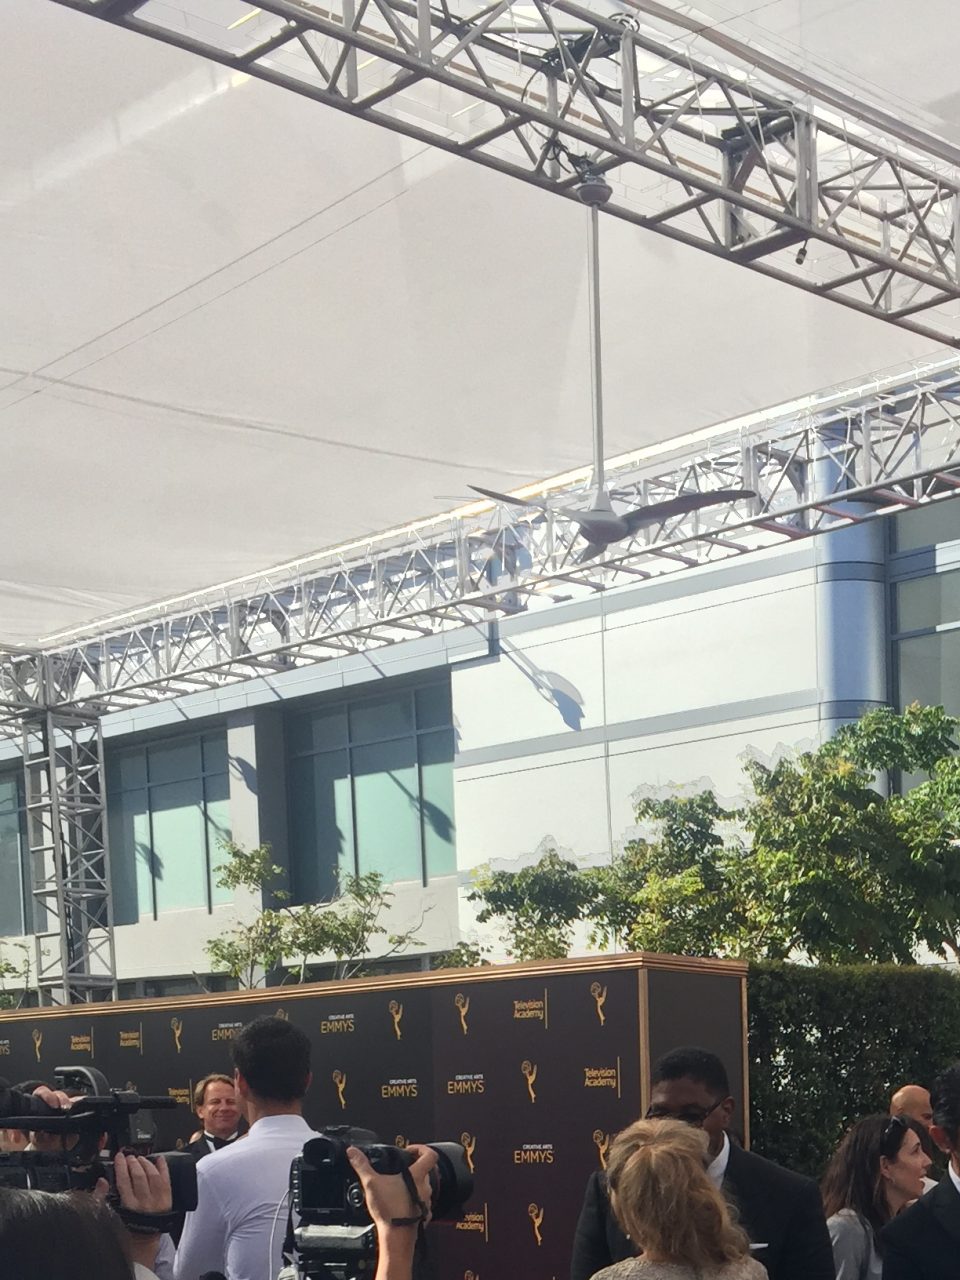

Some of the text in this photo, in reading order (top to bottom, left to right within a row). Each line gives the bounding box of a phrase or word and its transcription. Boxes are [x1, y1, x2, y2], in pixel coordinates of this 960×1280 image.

[513, 1000, 544, 1010] Television
[513, 1009, 544, 1020] Academy
[320, 1019, 355, 1034] EMMYS
[584, 1068, 616, 1078] Television
[447, 1080, 485, 1095] EMMYS
[584, 1077, 616, 1088] Academy
[381, 1084, 418, 1098] EMMYS
[514, 1150, 554, 1164] EMMYS
